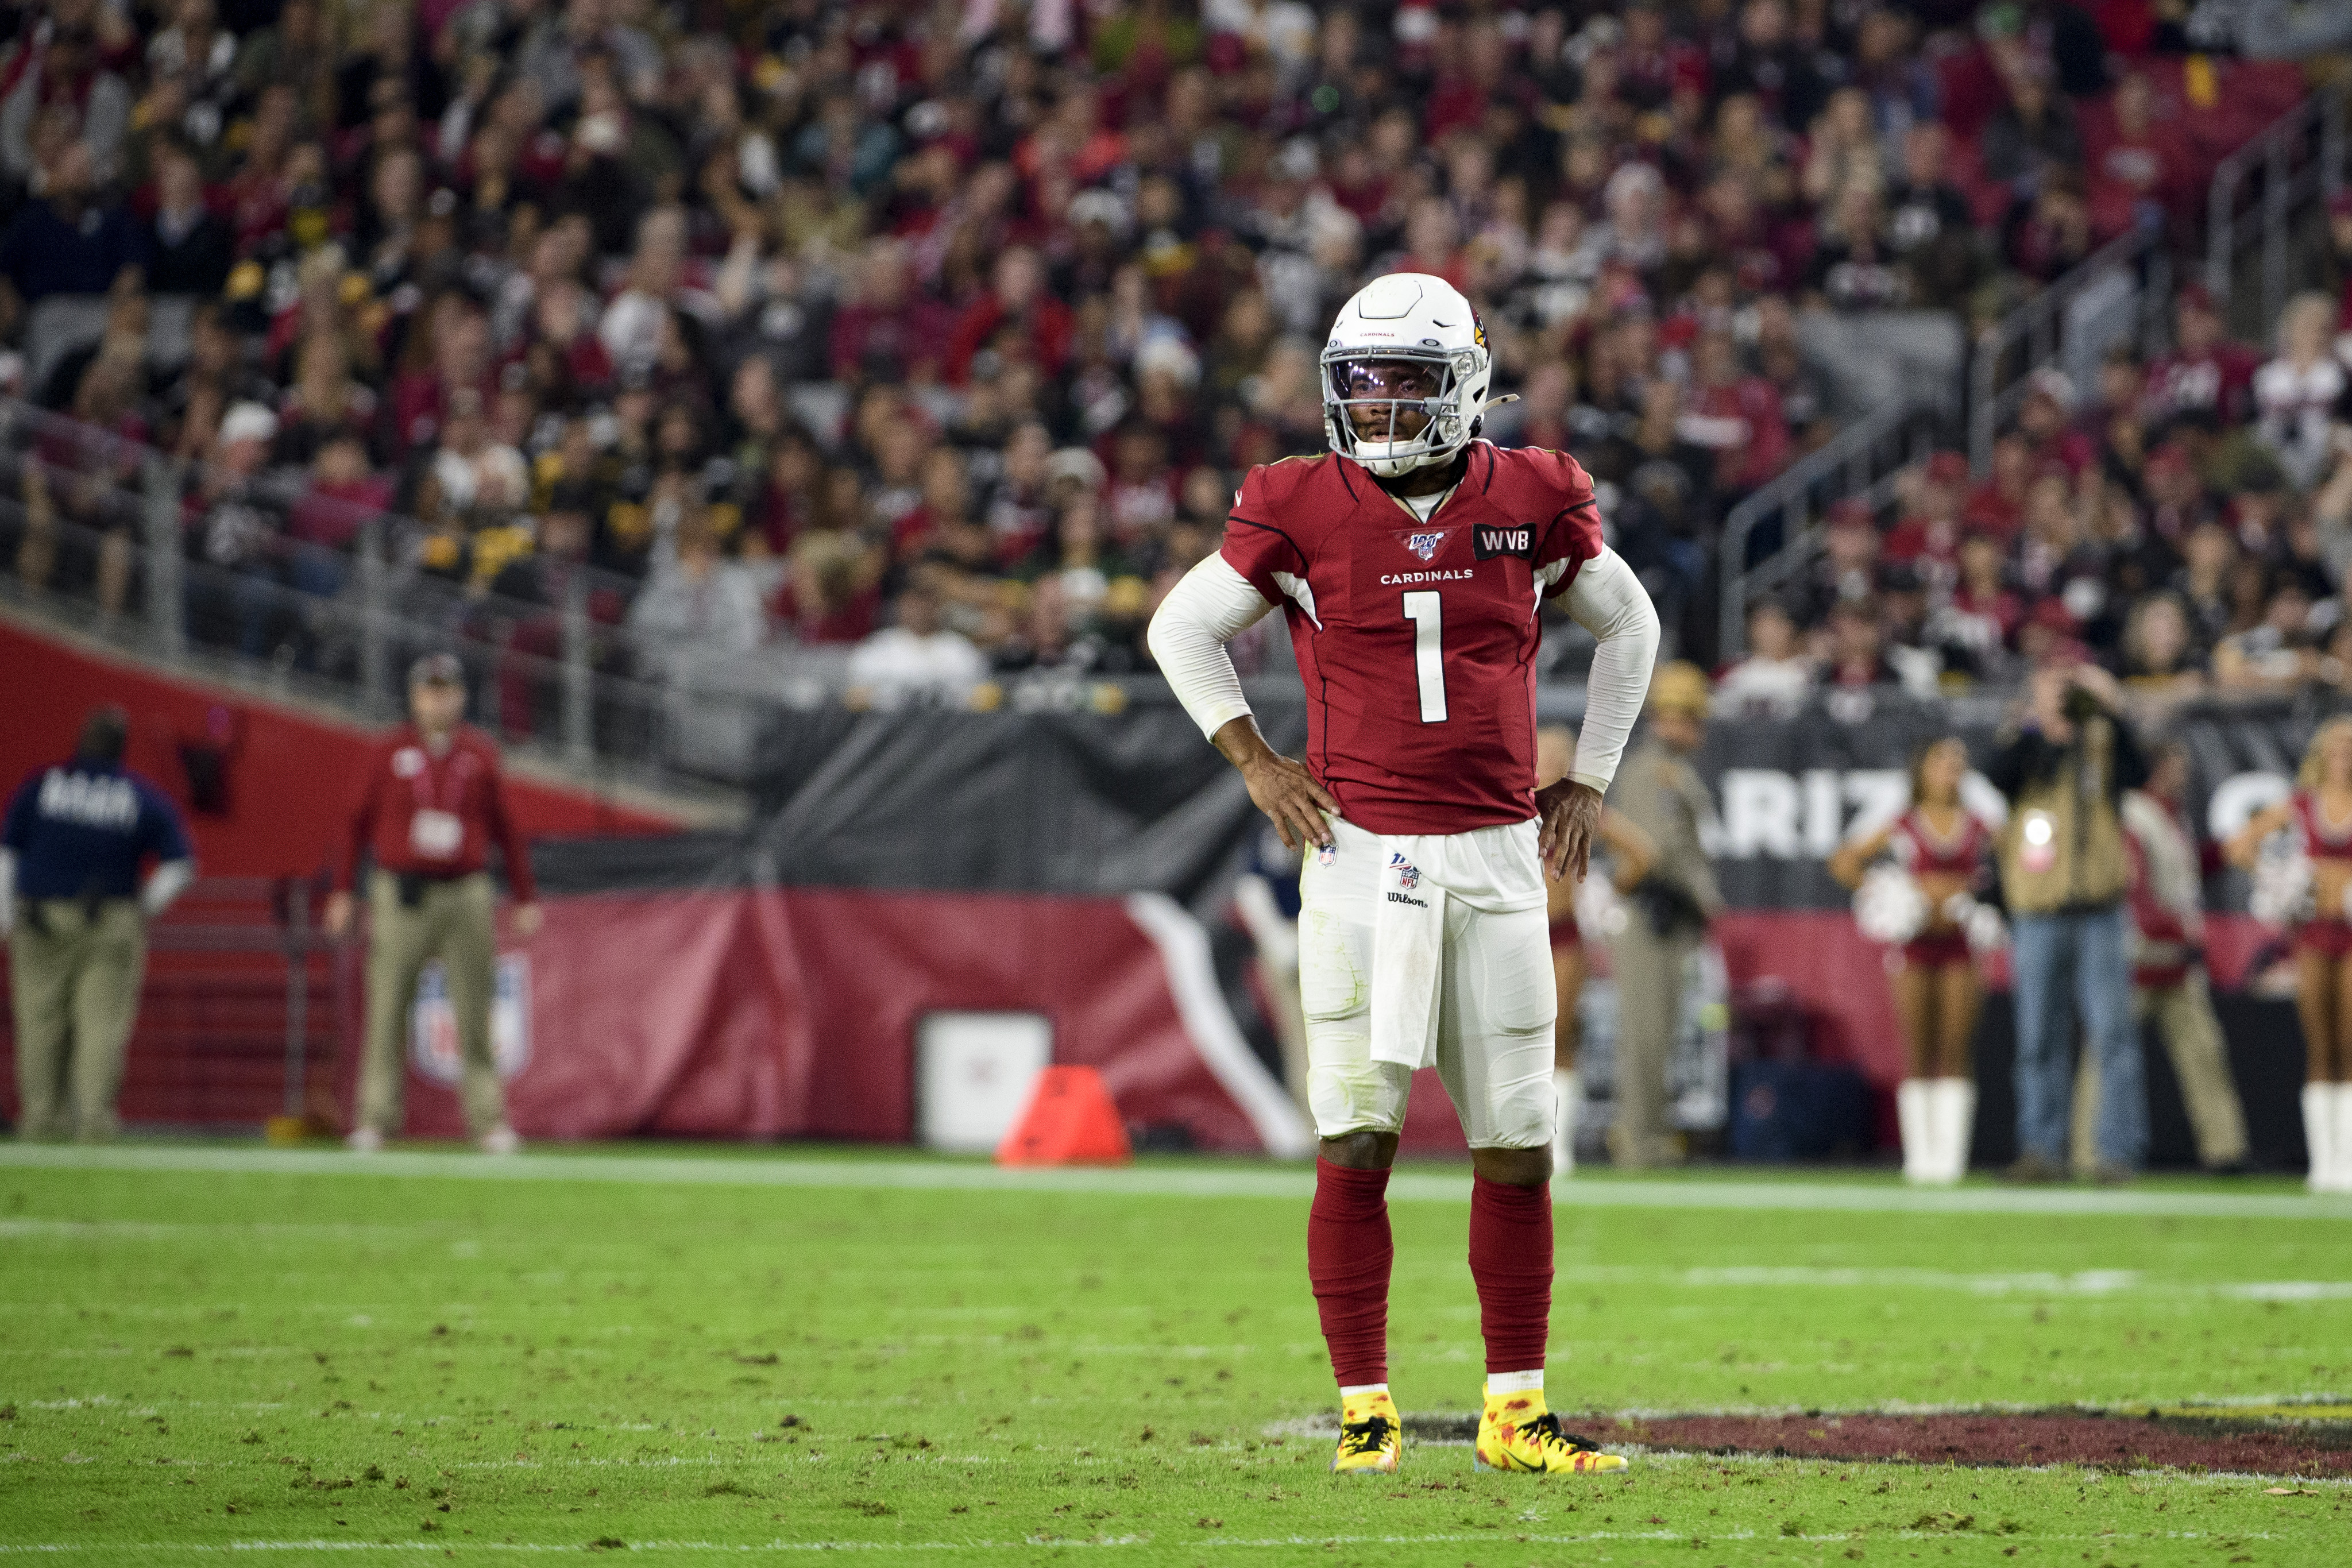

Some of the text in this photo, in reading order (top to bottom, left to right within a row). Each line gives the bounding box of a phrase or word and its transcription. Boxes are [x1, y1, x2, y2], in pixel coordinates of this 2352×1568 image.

[1481, 531, 1529, 550] WVB
[1380, 569, 1473, 585] CARDINALS
[1402, 590, 1449, 723] 1
[1401, 877, 1416, 887] NFL
